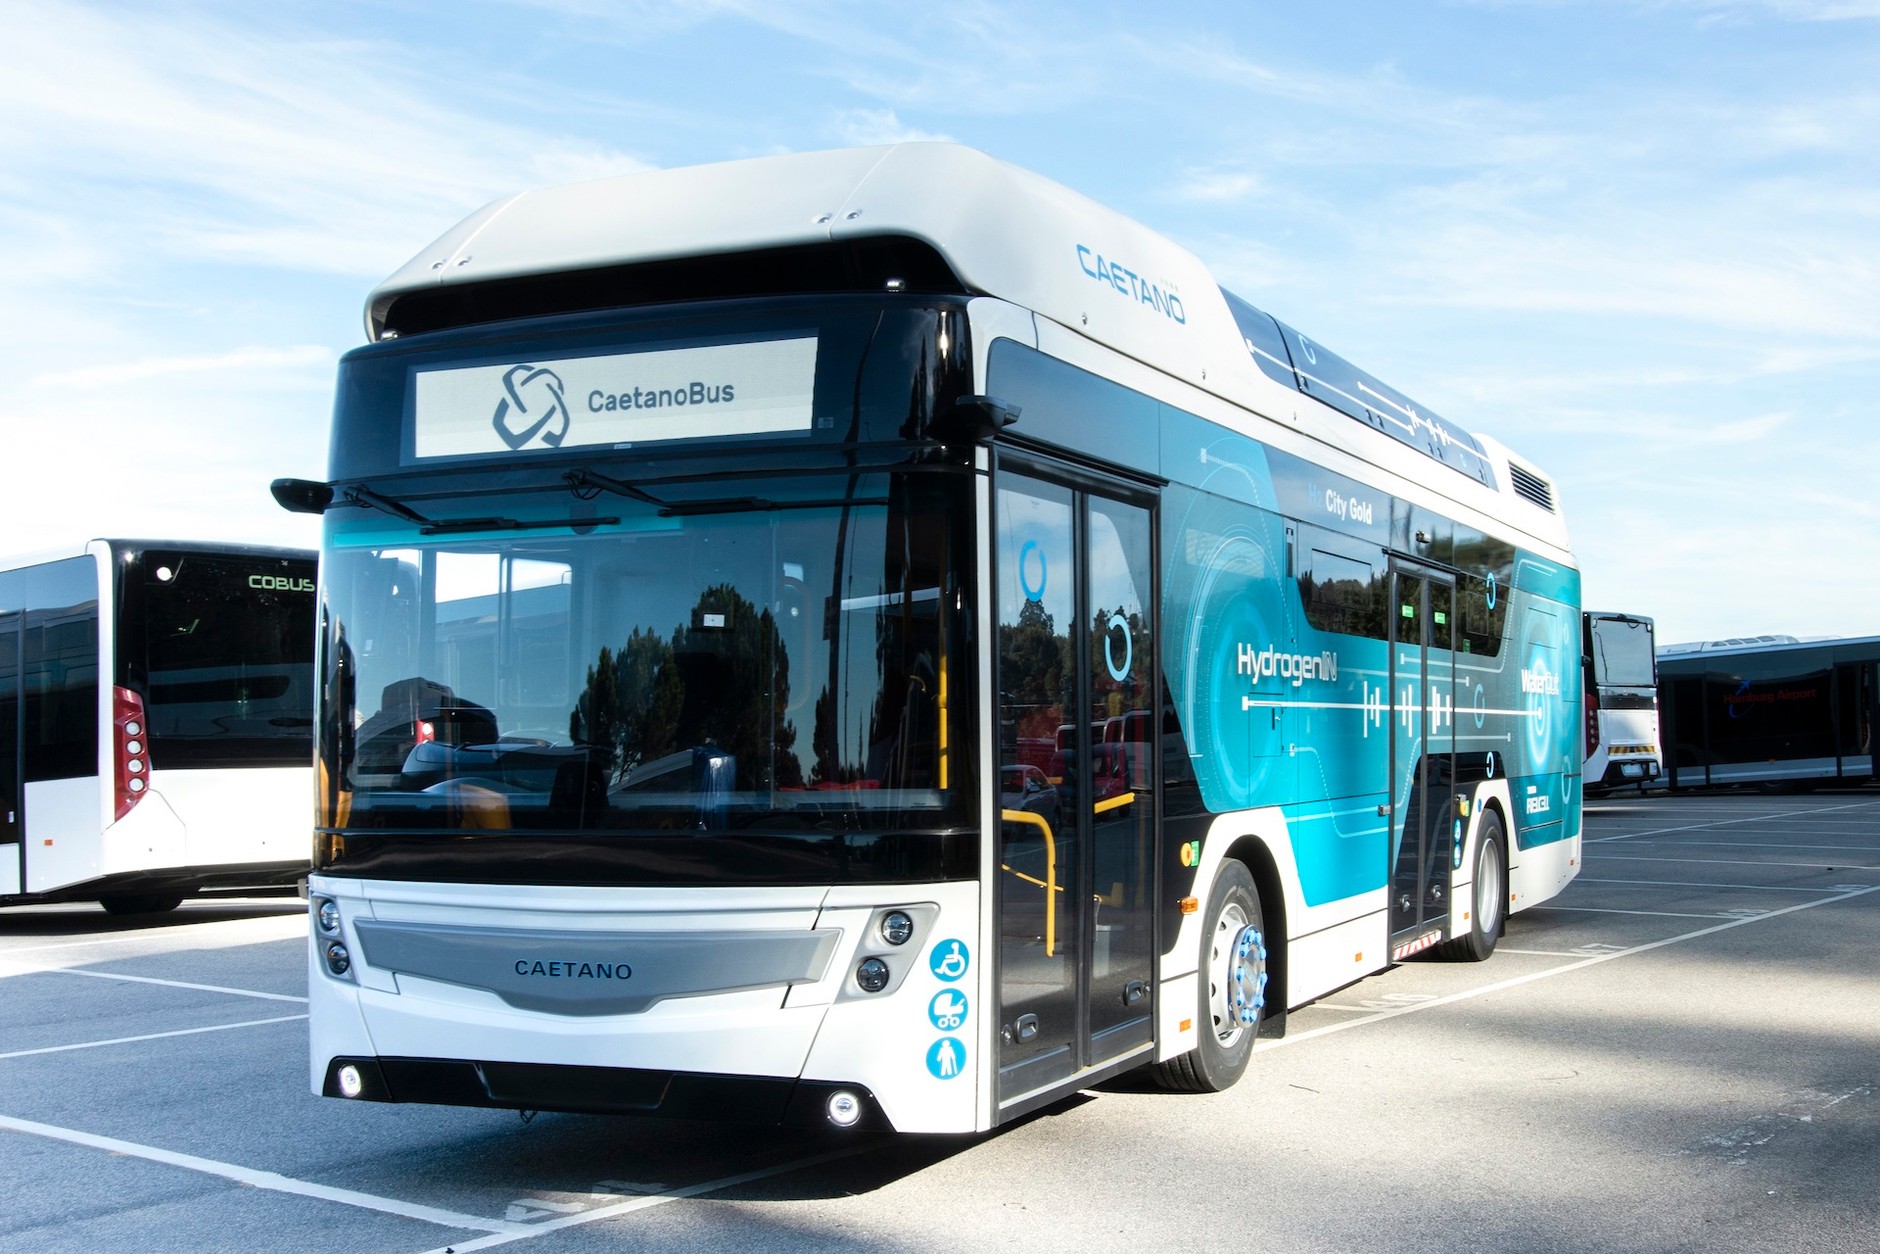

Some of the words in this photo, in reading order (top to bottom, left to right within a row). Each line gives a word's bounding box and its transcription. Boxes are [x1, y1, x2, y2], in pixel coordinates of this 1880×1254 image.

[1076, 243, 1186, 325] CAETANO
[587, 381, 736, 413] CaetanoBus
[1325, 488, 1347, 521] City
[1349, 497, 1373, 525] Gold
[248, 574, 316, 592] COBUS
[1723, 692, 1775, 704] Hamburg
[1777, 688, 1817, 702] Airport
[514, 959, 633, 980] CAETANO
